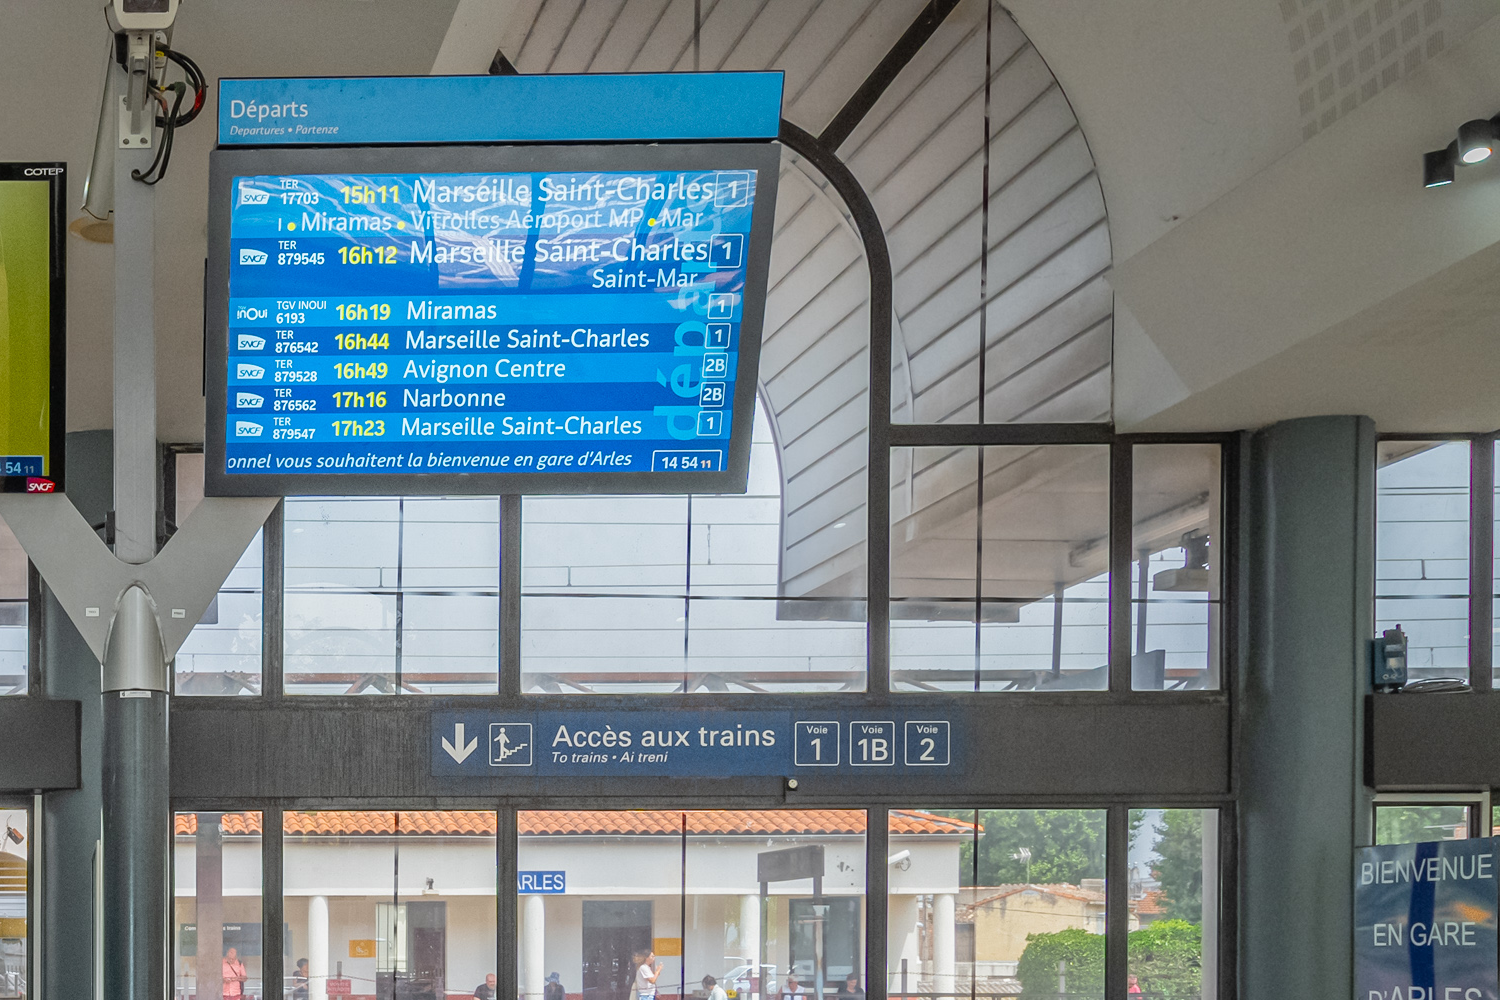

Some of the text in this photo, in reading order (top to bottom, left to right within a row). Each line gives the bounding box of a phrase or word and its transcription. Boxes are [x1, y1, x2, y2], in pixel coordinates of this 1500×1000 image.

[230, 100, 309, 122] Départs
[230, 125, 339, 137] Departures Partenze
[24, 168, 64, 176] COTEP
[280, 179, 319, 205] TER 17703
[340, 177, 738, 204] 15h11 Marseille Saint-Charles 1
[301, 208, 704, 233] Miramas Vitrolles Aéroport MP Mar
[278, 241, 325, 265] TER 879545
[338, 238, 732, 264] 16h12 Marseille Saint-Charles 1
[592, 268, 699, 289] Saint-Mar
[276, 299, 726, 324] 6193 16h19 Miramas 1
[277, 300, 327, 310] TGV INOUI
[275, 330, 318, 353] TER 876542
[334, 328, 723, 350] 16h44 Marseille Saint-Charles 1
[274, 360, 318, 382] TER 879528
[334, 358, 725, 383] 16h49 Avignon Centre 2B
[273, 388, 316, 411] TER 876562
[332, 388, 722, 408] 17h16 Narbonne 2B
[272, 417, 316, 440] TER 879547
[332, 416, 715, 436] 17h23 Marseille Saint-Charles 1
[5, 462, 21, 474] 54
[228, 451, 632, 469] onnel vous souhaitent la bienvenue en gare d'Arles
[662, 457, 698, 469] 14 54
[28, 482, 53, 491] SNCF
[552, 724, 776, 747] Accès aux trains
[806, 725, 939, 734] Voie Voie Voie
[551, 751, 668, 763] To trains Ai treni
[811, 738, 935, 761] 1 1B 2
[1361, 854, 1493, 885] BIENVENUE
[1373, 921, 1476, 946] EN GARE
